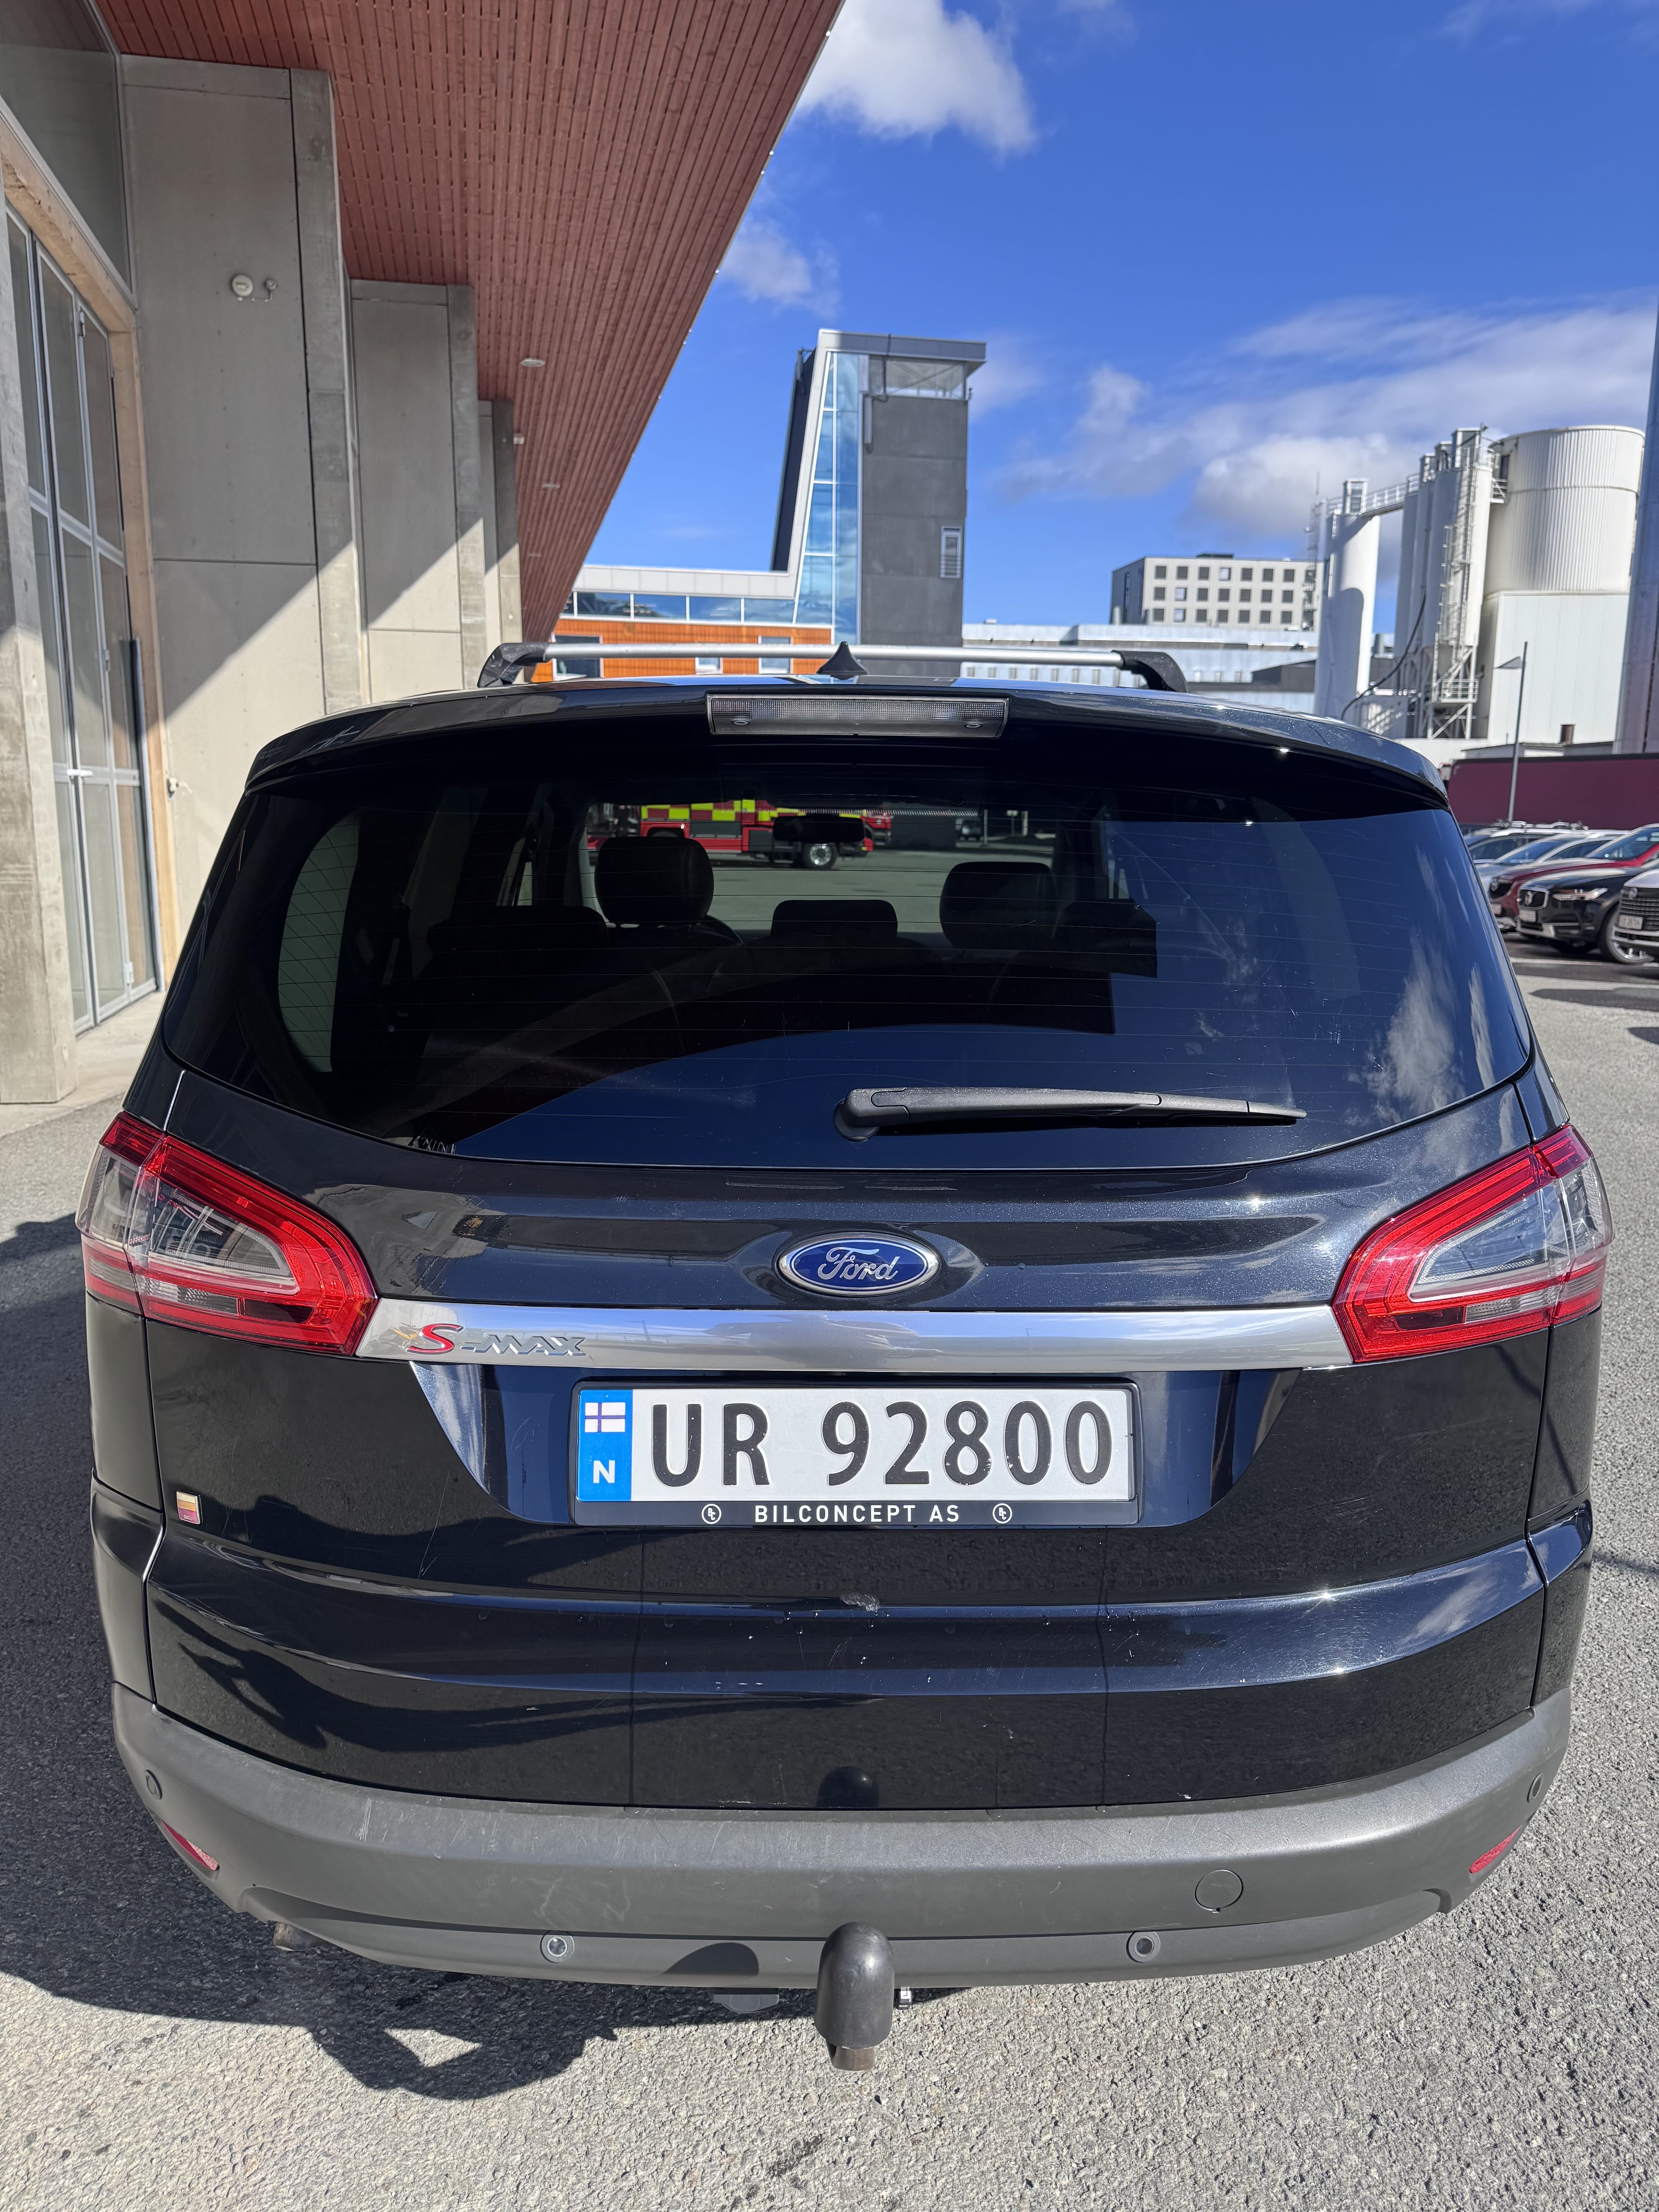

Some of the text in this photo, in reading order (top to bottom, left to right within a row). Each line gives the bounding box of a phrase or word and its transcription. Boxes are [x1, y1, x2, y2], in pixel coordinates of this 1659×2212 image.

[817, 1247, 900, 1280] Ford
[405, 1323, 587, 1356] S-MAX
[653, 1401, 1111, 1487] UR 92800
[593, 1460, 615, 1483] N
[755, 1505, 915, 1523] BILCONCEPT
[929, 1504, 959, 1522] AS
